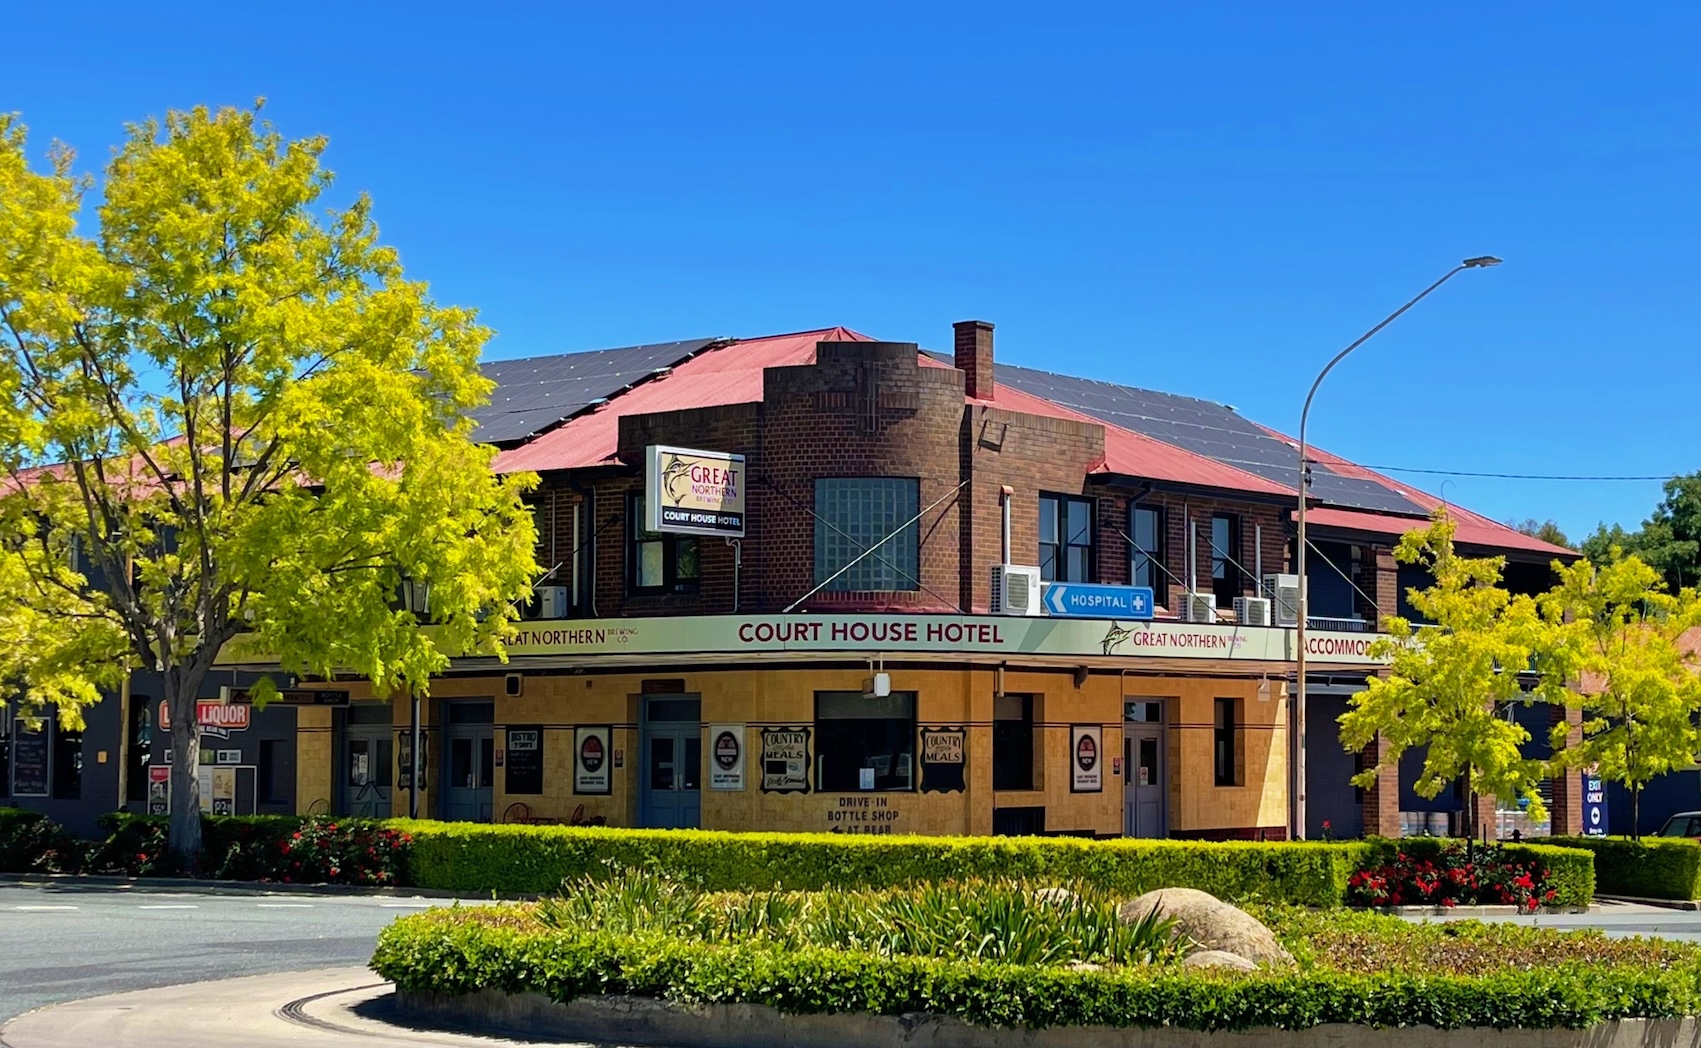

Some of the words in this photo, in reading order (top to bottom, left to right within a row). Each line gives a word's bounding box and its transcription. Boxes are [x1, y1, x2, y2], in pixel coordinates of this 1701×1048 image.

[691, 466, 738, 486] GREAT
[692, 485, 737, 498] NORTHERN
[664, 511, 690, 521] COURT
[691, 514, 716, 524] HOUSE
[718, 516, 741, 526] HOTEL
[1071, 594, 1128, 608] HOSPITAL
[532, 629, 605, 645] NORTHERN
[738, 623, 823, 643] COURT
[831, 622, 918, 642] HOUSE
[926, 623, 1004, 643] HOTEL
[1133, 631, 1168, 646] GREAT
[1169, 633, 1226, 648] NORTHERN
[511, 732, 537, 742] BISTRO
[765, 733, 805, 747] COUNTRY
[926, 735, 961, 749] COUNTRY
[766, 751, 804, 759] MEALS
[926, 753, 960, 761] MEALS
[1588, 780, 1602, 791] EXIT
[1587, 792, 1603, 803] ONLY
[827, 811, 867, 821] BOTTLE
[871, 811, 899, 821] SHOP
[847, 825, 859, 834] AT
[864, 825, 892, 834] REAR
